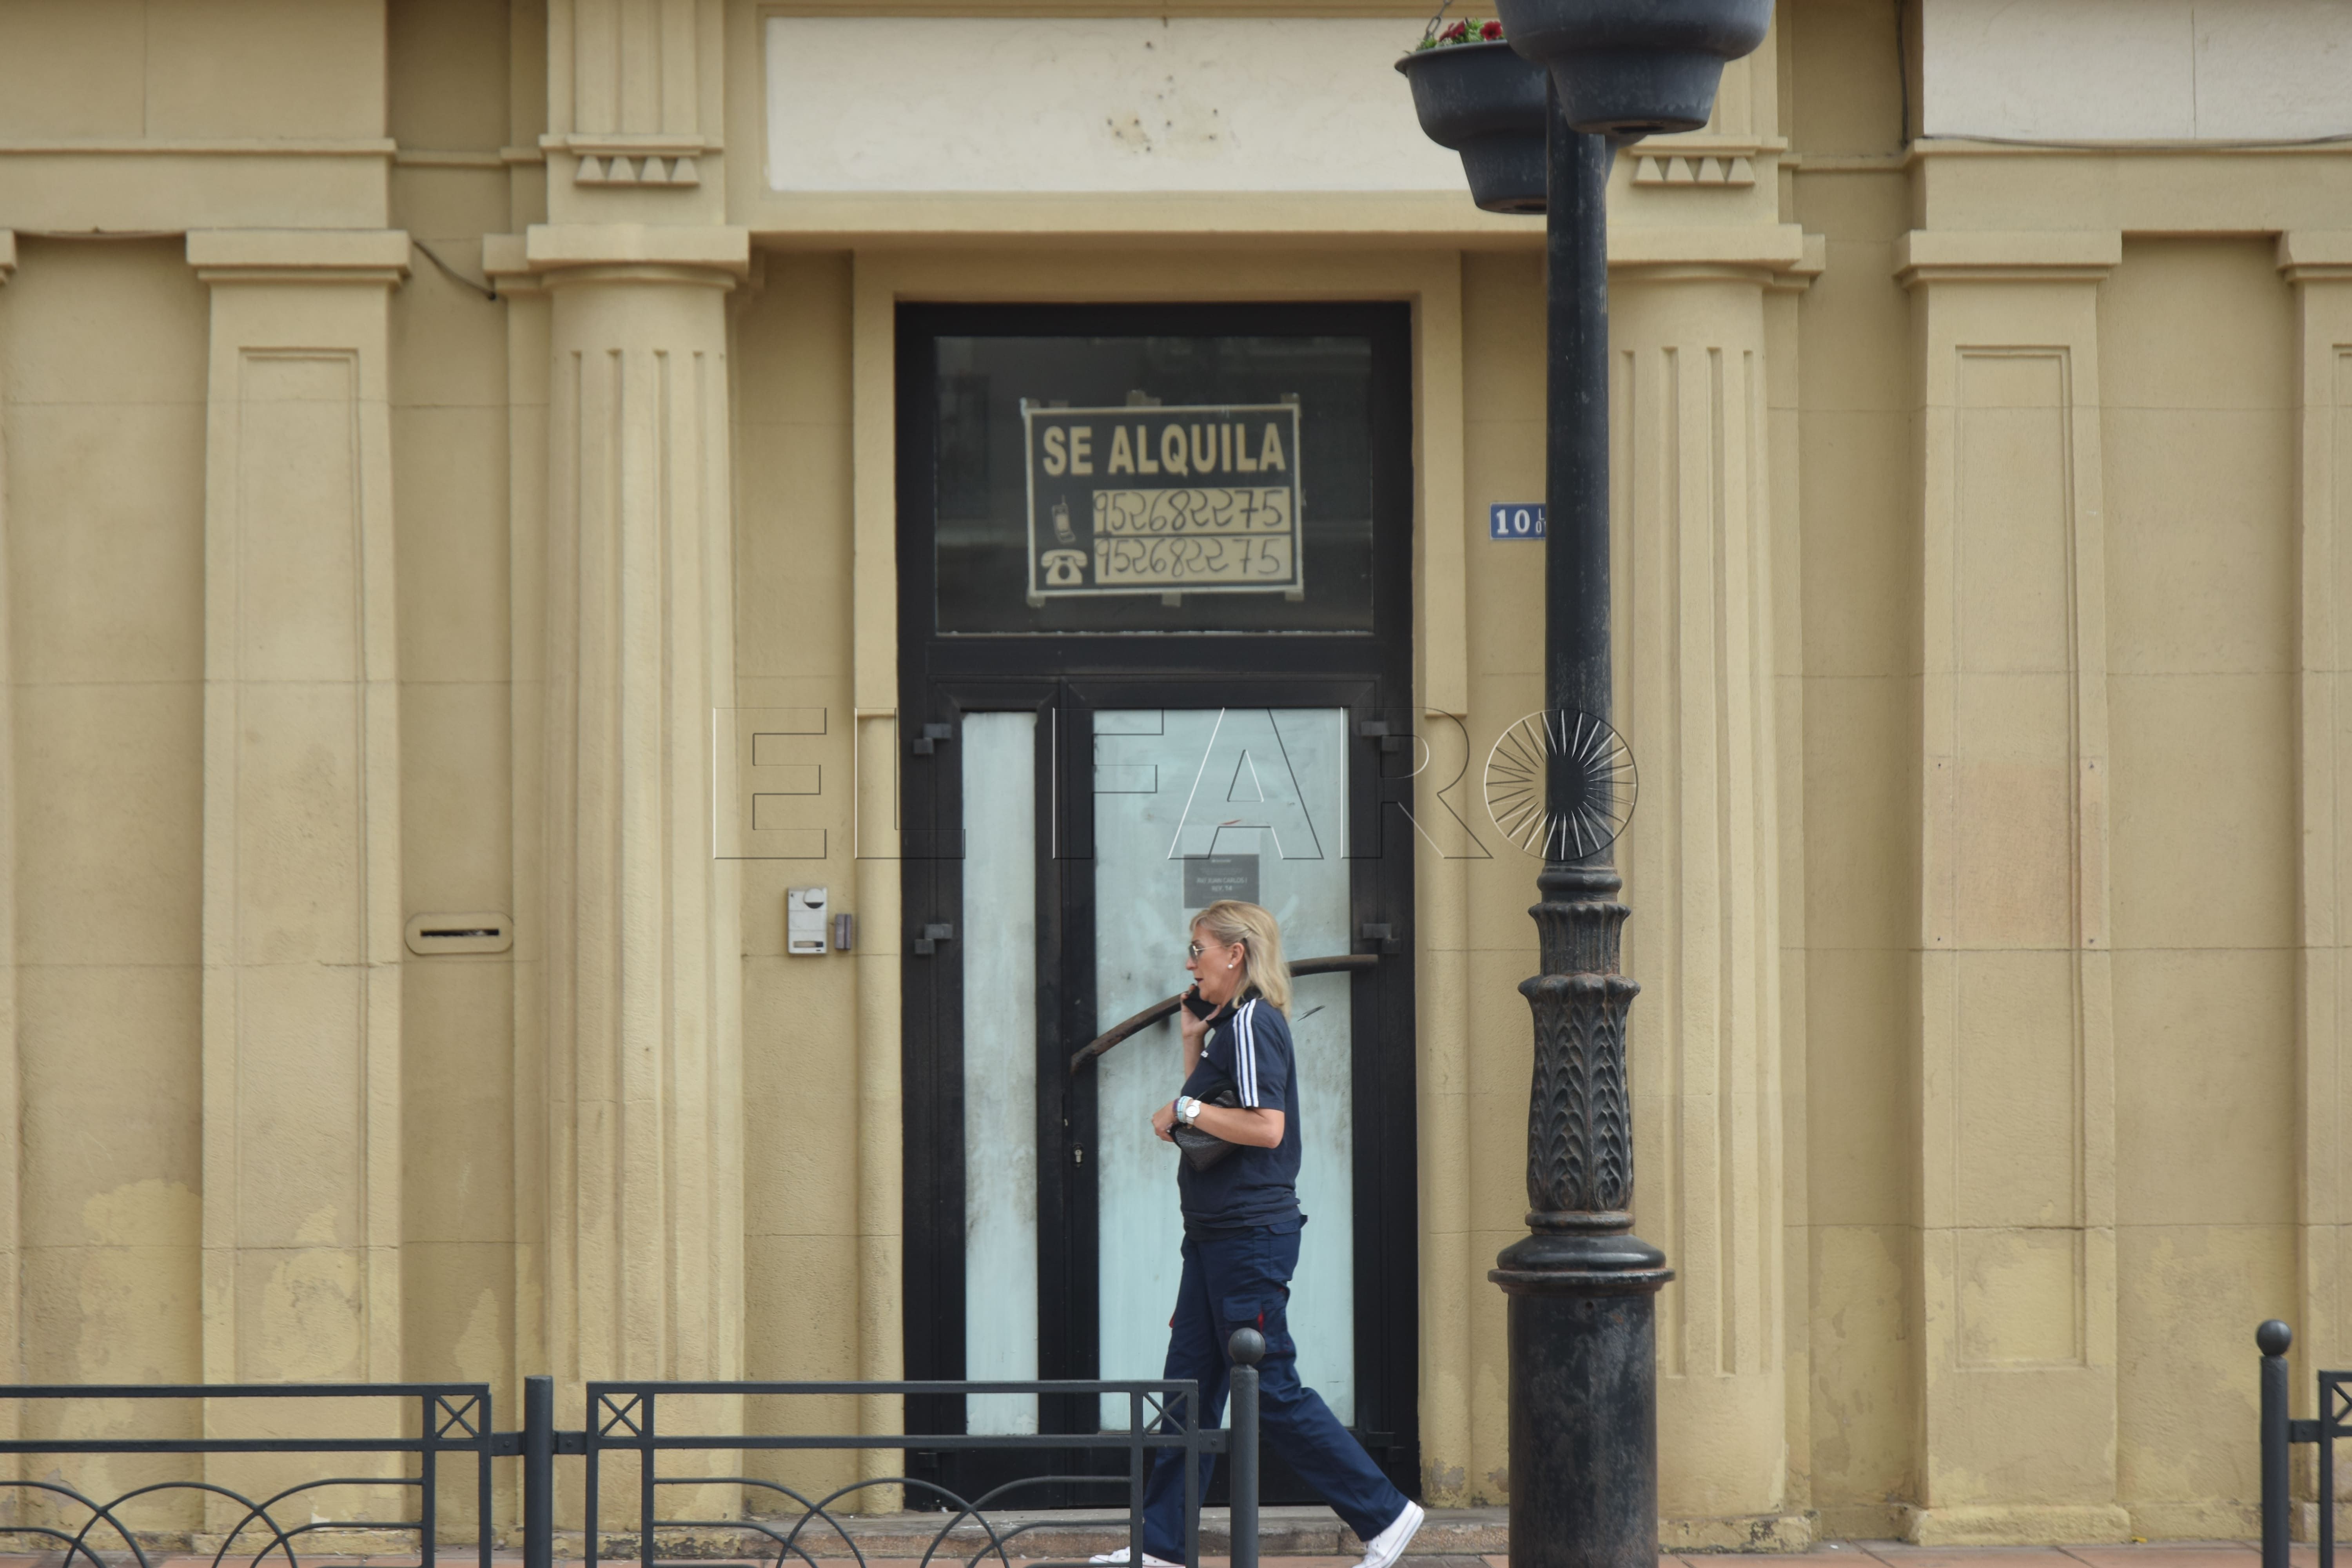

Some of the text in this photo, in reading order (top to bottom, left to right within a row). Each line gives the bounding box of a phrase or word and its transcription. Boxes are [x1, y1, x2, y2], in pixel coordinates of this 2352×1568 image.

[1043, 422, 1286, 477] SE ALQUILA
[1095, 489, 1283, 534] 952682275
